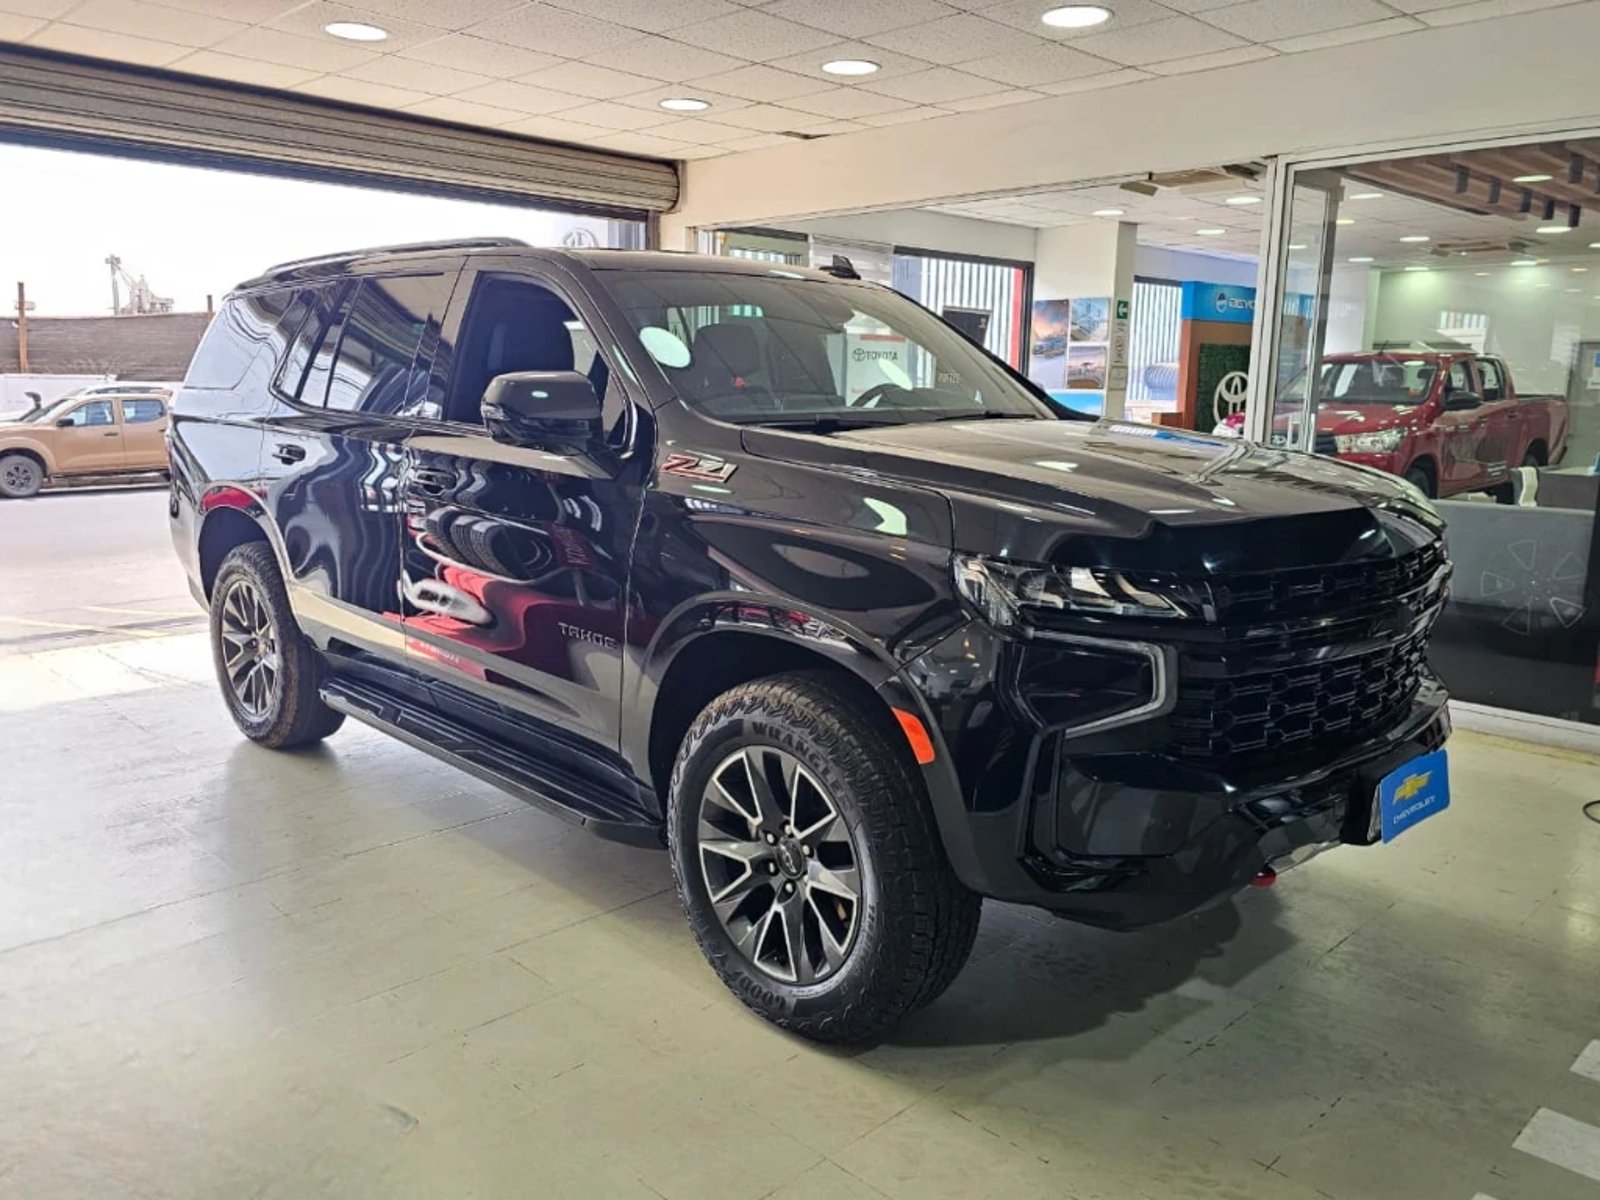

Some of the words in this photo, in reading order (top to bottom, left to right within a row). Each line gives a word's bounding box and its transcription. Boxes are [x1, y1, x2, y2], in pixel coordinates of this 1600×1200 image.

[866, 351, 898, 361] TOYOTA
[660, 453, 740, 484] Z71
[557, 621, 617, 650] TAHOE
[1392, 795, 1436, 825] CHEVROLET
